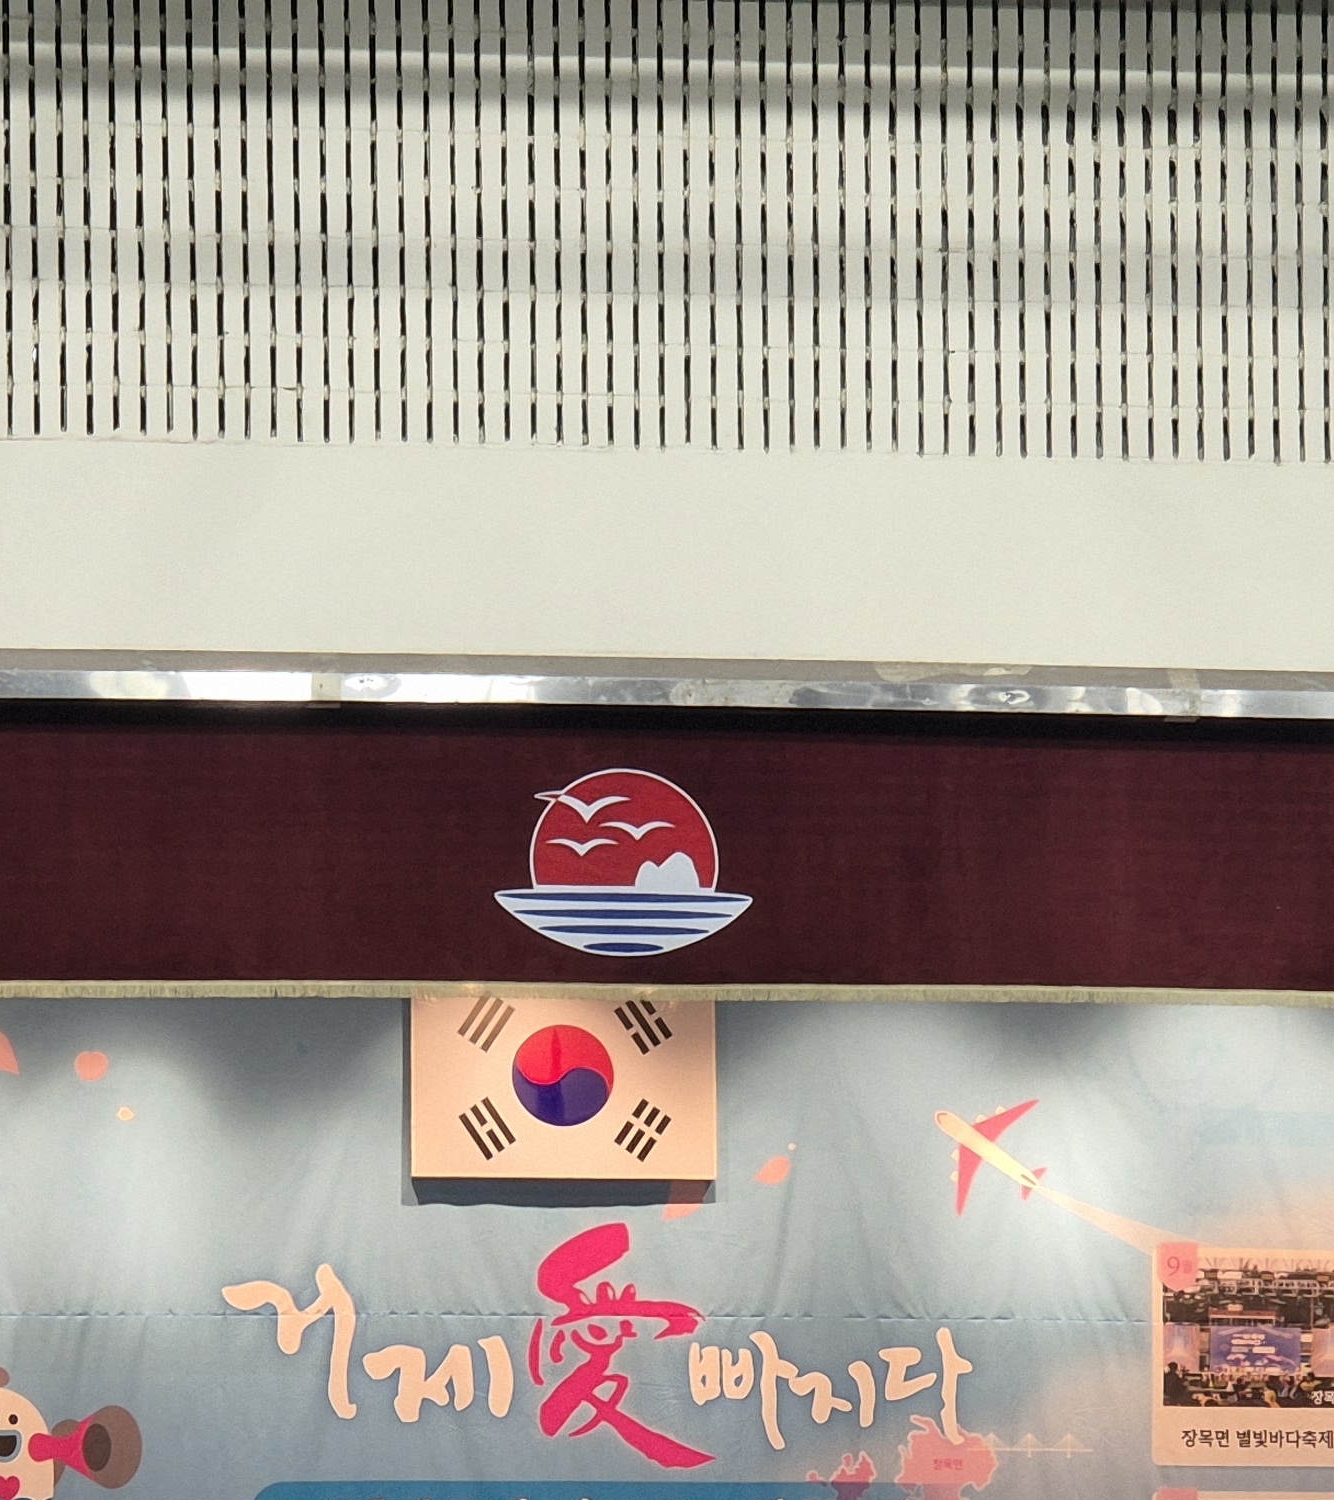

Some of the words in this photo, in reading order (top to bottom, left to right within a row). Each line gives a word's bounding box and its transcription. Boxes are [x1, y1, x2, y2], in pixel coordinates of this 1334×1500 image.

[689, 1326, 972, 1449] 빠지다
[1181, 1429, 1229, 1448] 장목면
[1236, 1430, 1334, 1449] 별빛바다축제
